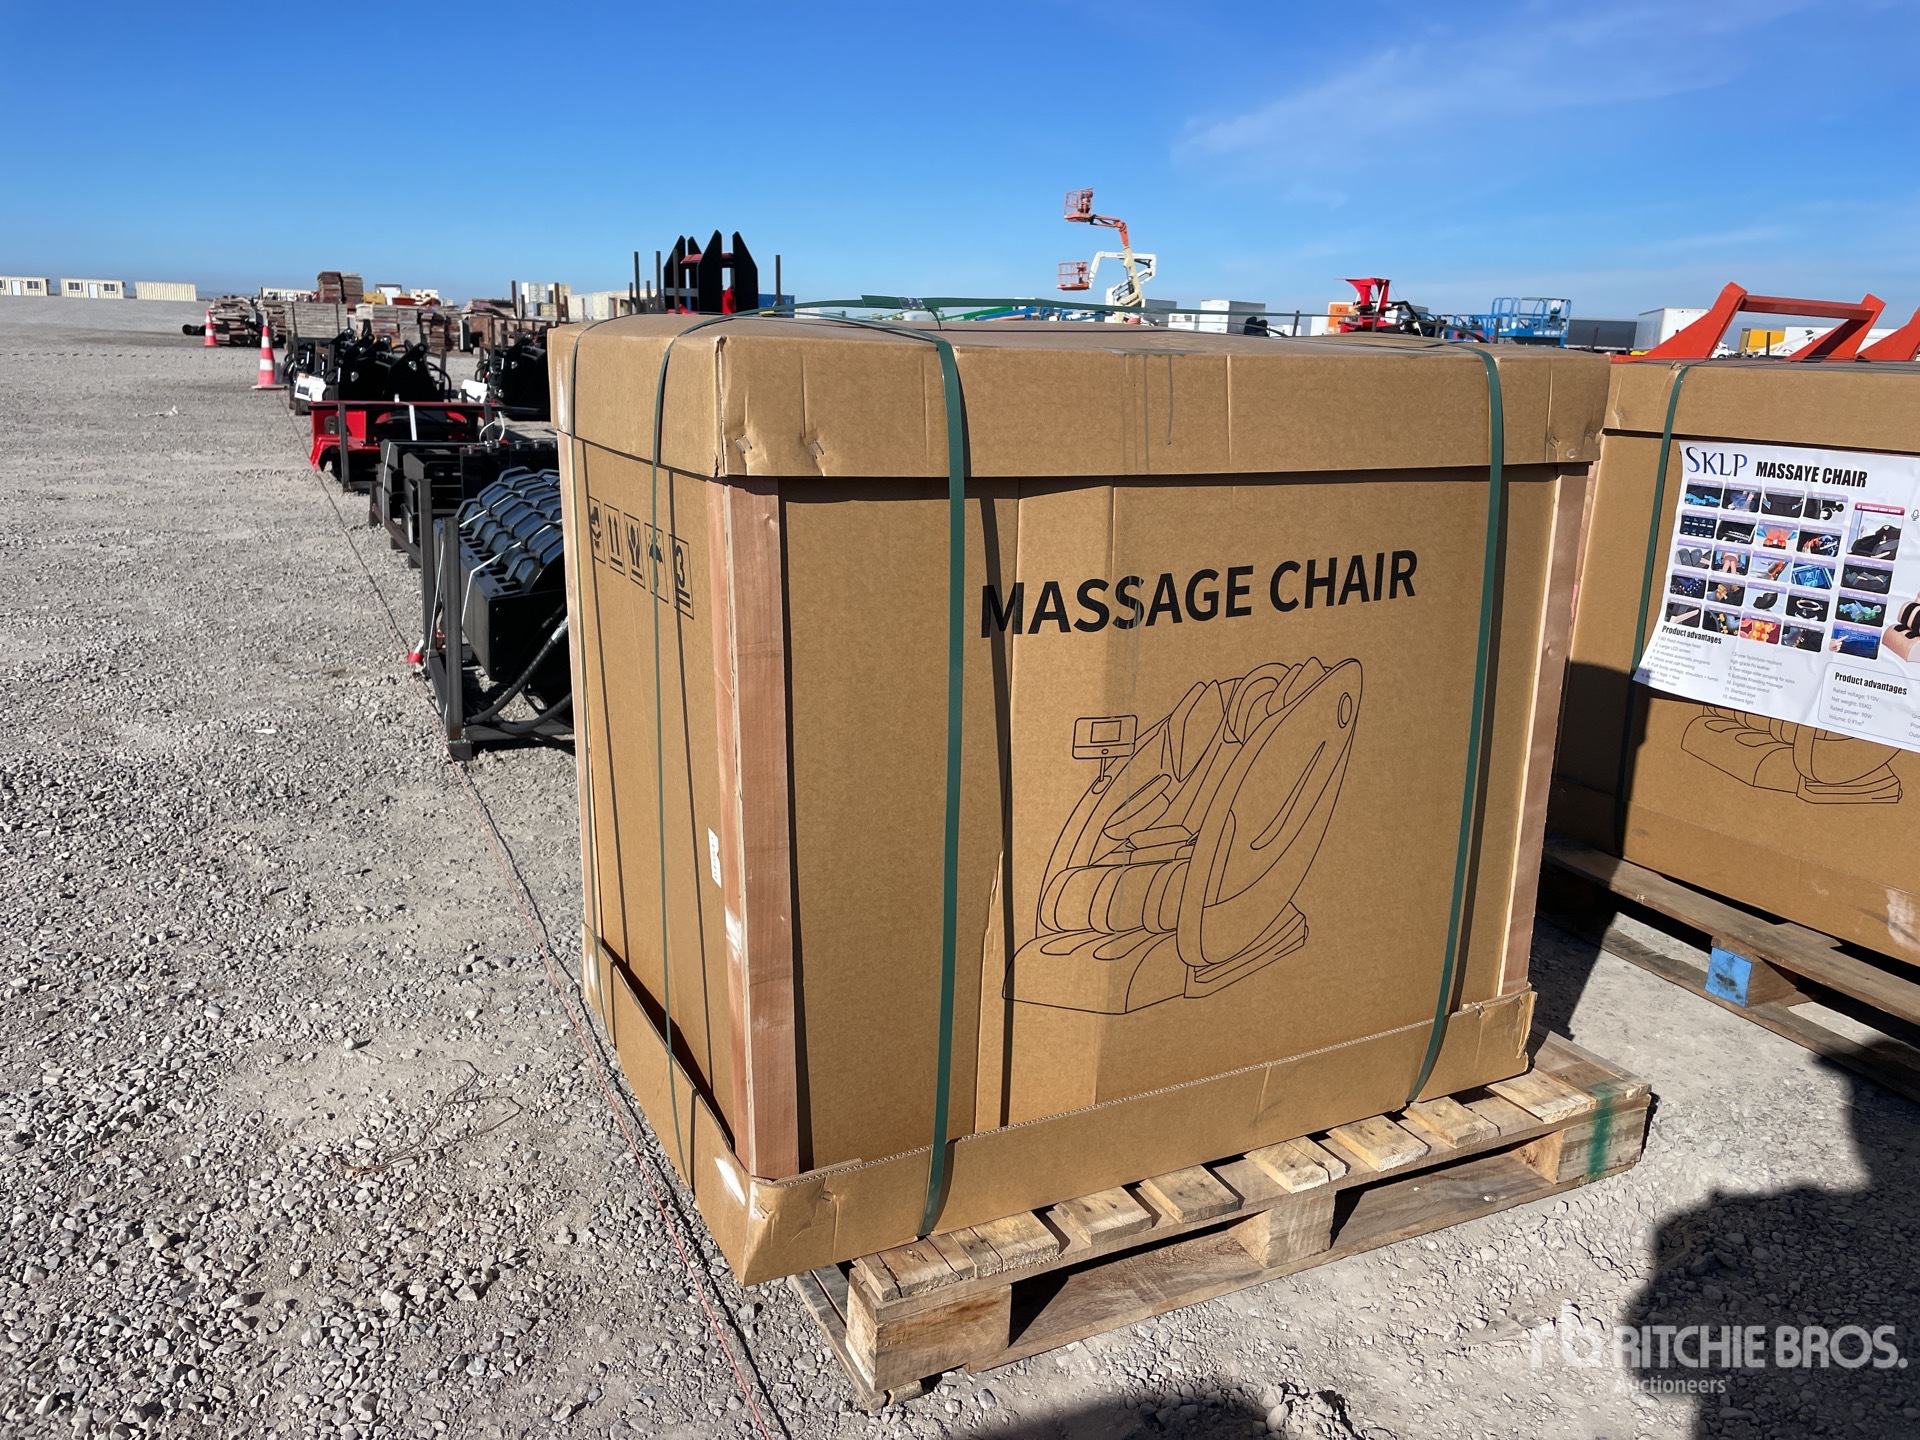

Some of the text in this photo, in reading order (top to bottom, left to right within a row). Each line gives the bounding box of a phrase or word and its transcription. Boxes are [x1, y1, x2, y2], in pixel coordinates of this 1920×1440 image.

[1685, 446, 1868, 488] SKLP MASSAYE CHAIR
[981, 549, 1418, 639] MASSAGE CHAIR
[1662, 625, 1722, 644] Product advantages
[1833, 687, 1846, 695] Rated
[1835, 672, 1908, 695] Product advantages
